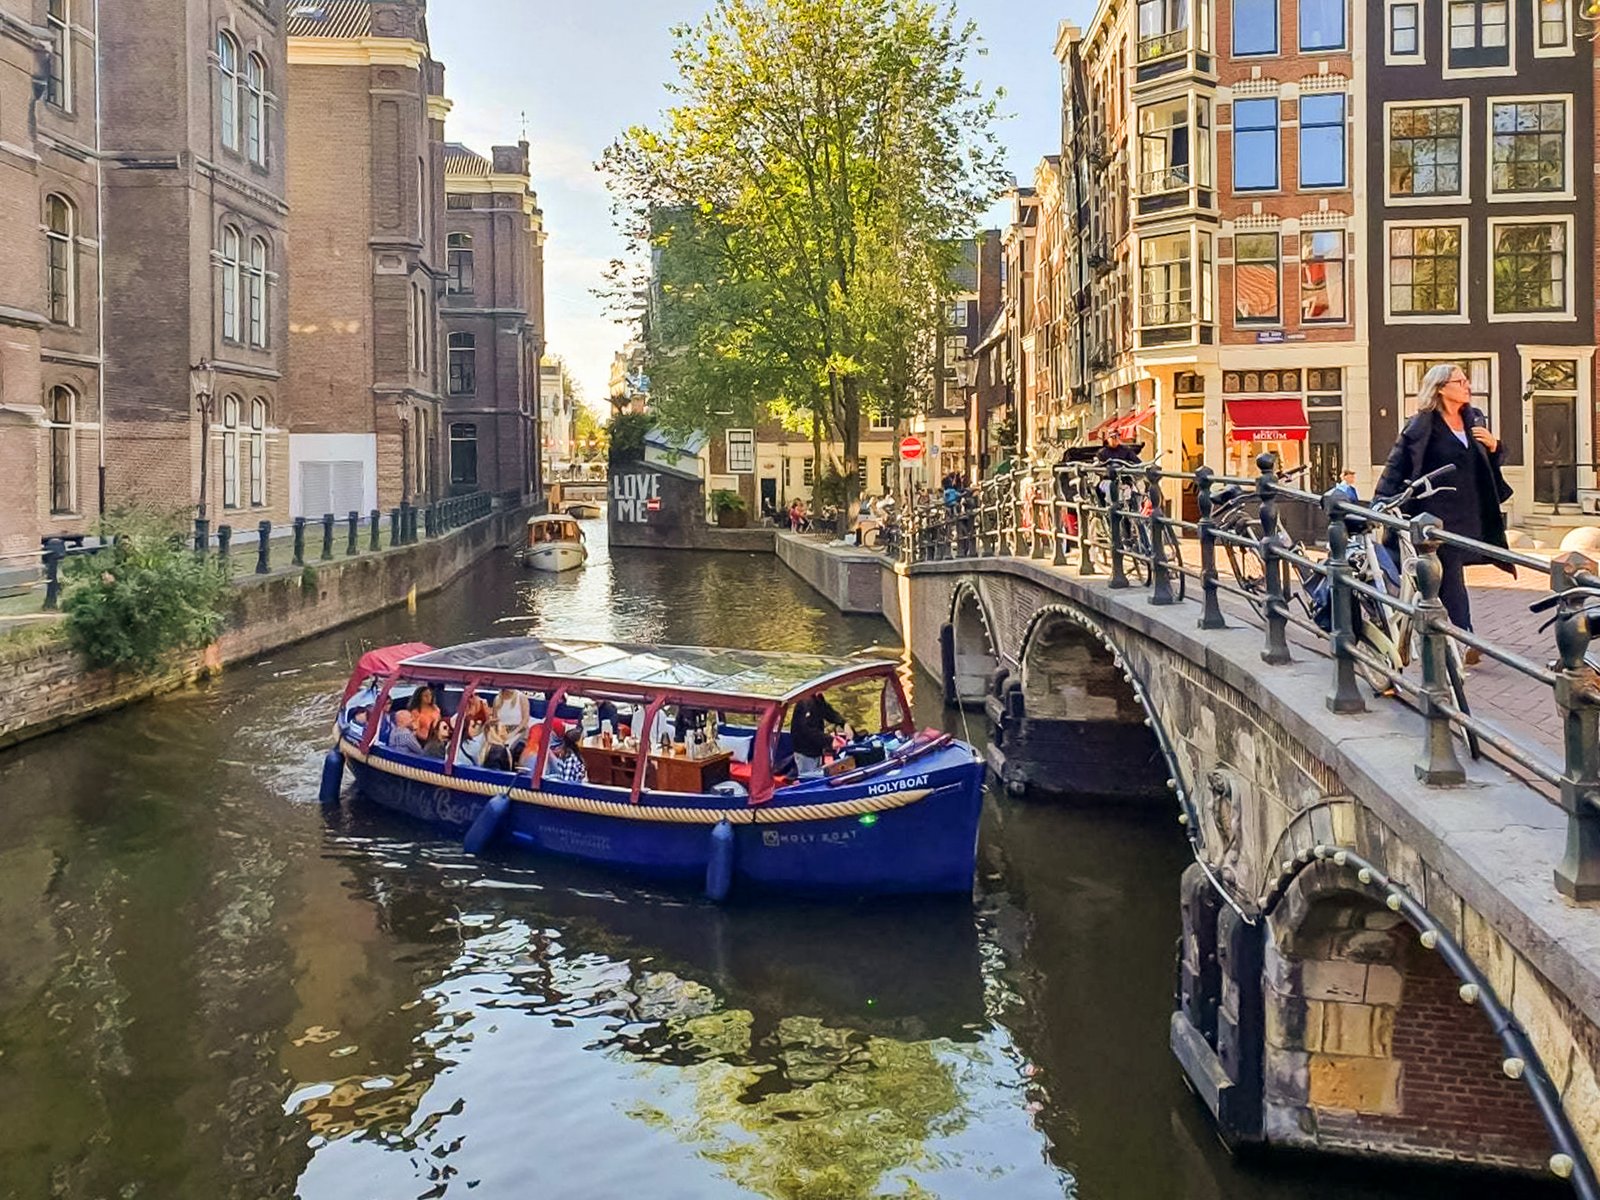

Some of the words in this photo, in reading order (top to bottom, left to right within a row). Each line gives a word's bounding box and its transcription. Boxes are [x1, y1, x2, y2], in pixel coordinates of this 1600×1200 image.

[614, 473, 662, 501] LOVE
[617, 500, 648, 523] ME
[868, 774, 930, 795] HOLYBOAT
[780, 833, 815, 844] HOLY
[821, 829, 857, 843] BOAT
